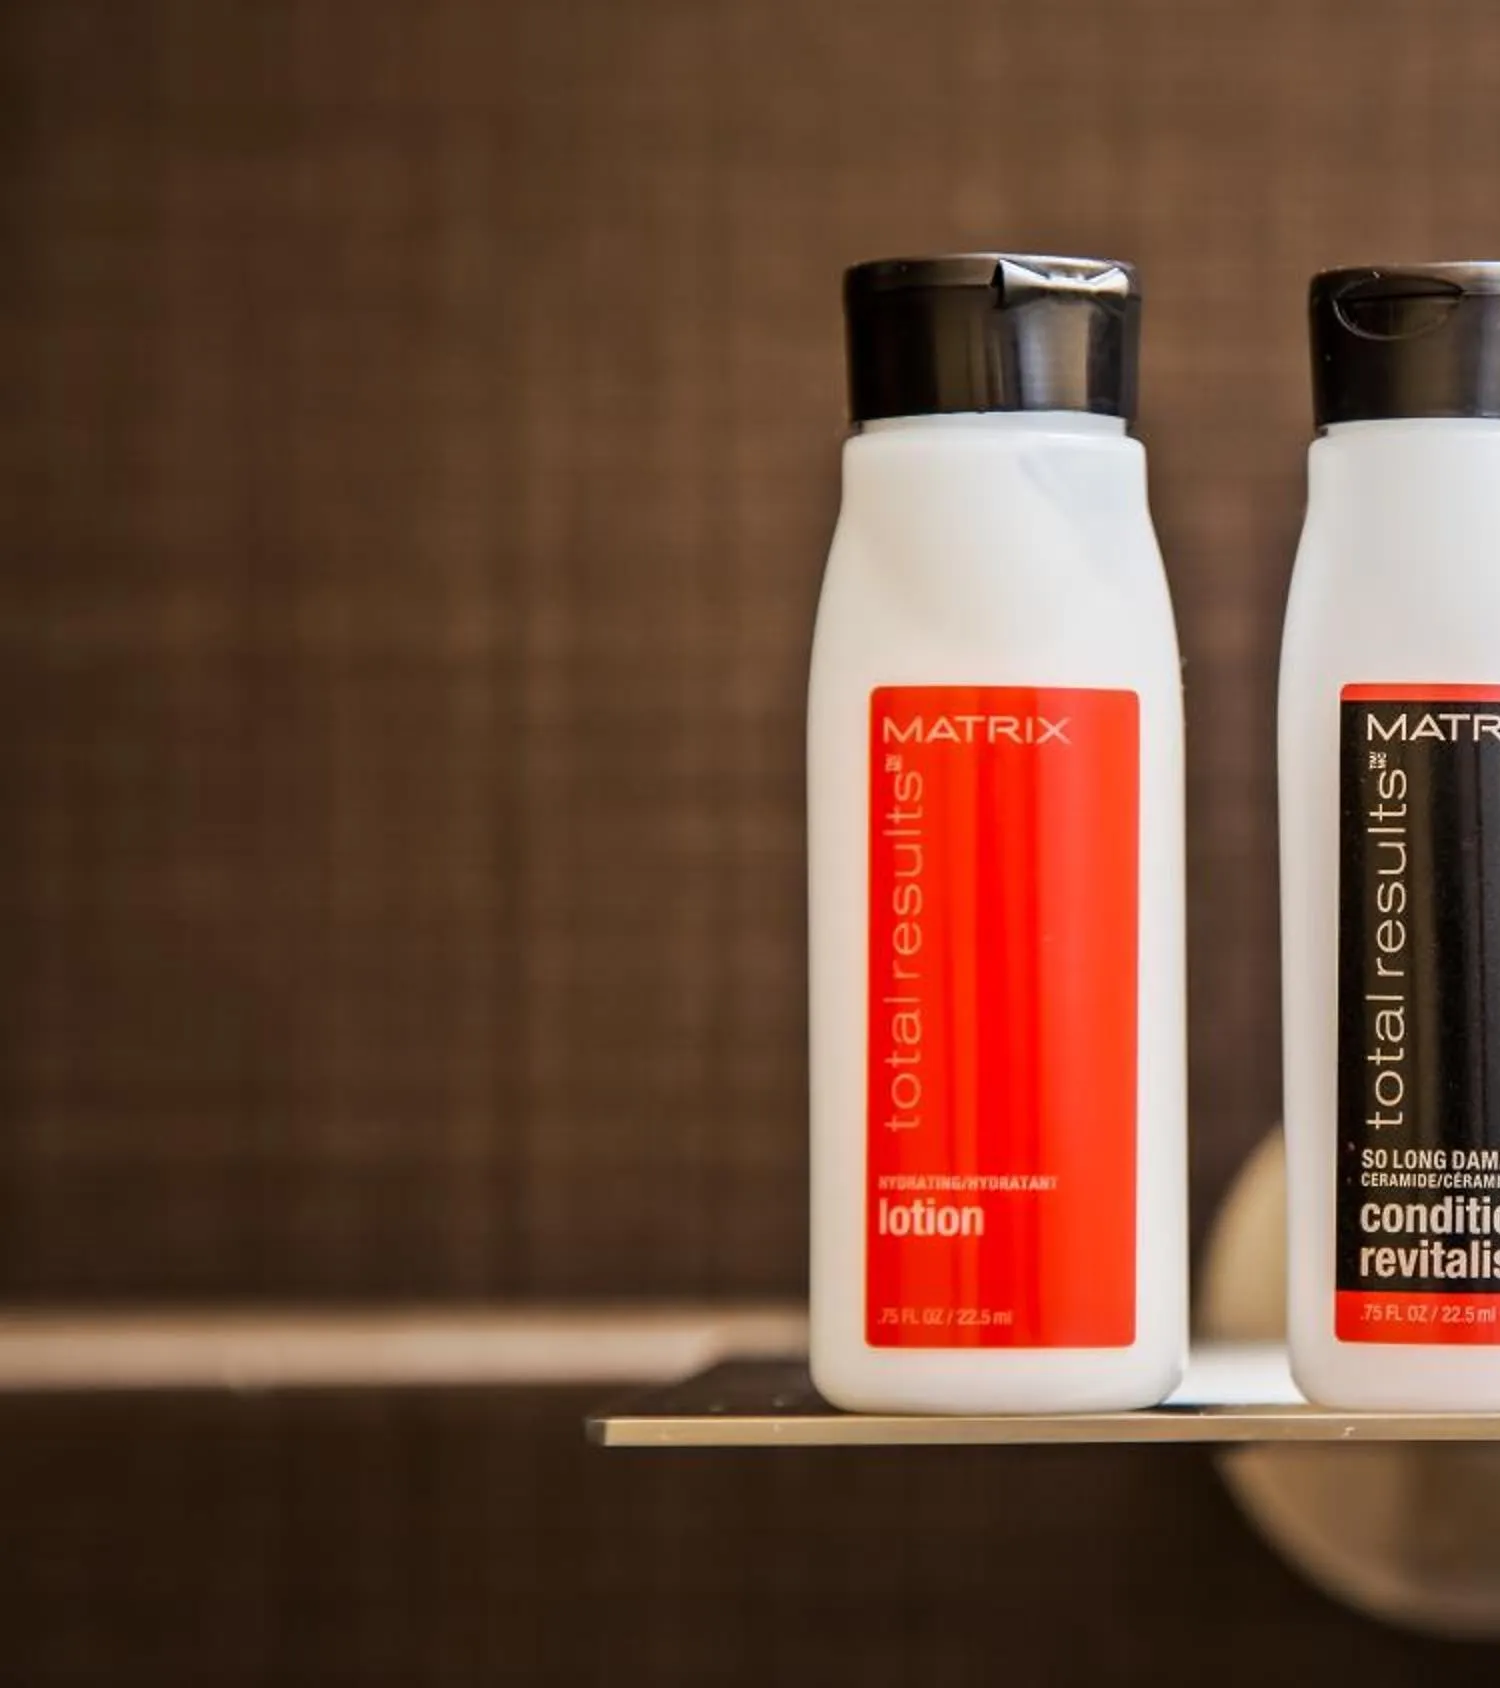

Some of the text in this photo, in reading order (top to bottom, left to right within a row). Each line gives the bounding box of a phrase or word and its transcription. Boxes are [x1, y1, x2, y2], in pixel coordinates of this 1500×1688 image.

[882, 715, 1072, 744] MATRIX
[883, 771, 923, 978] results
[1365, 768, 1407, 1129] total results
[883, 996, 923, 1132] total
[1361, 1149, 1387, 1169] SO
[1393, 1150, 1447, 1170] LONG
[878, 1197, 984, 1236] lotion
[902, 1309, 920, 1324] FL
[993, 1310, 1012, 1325] ml
[1386, 1305, 1401, 1321] FL
[1408, 1305, 1427, 1322] OZ
[1441, 1305, 1475, 1323] 22.5
[1477, 1306, 1496, 1322] ml
